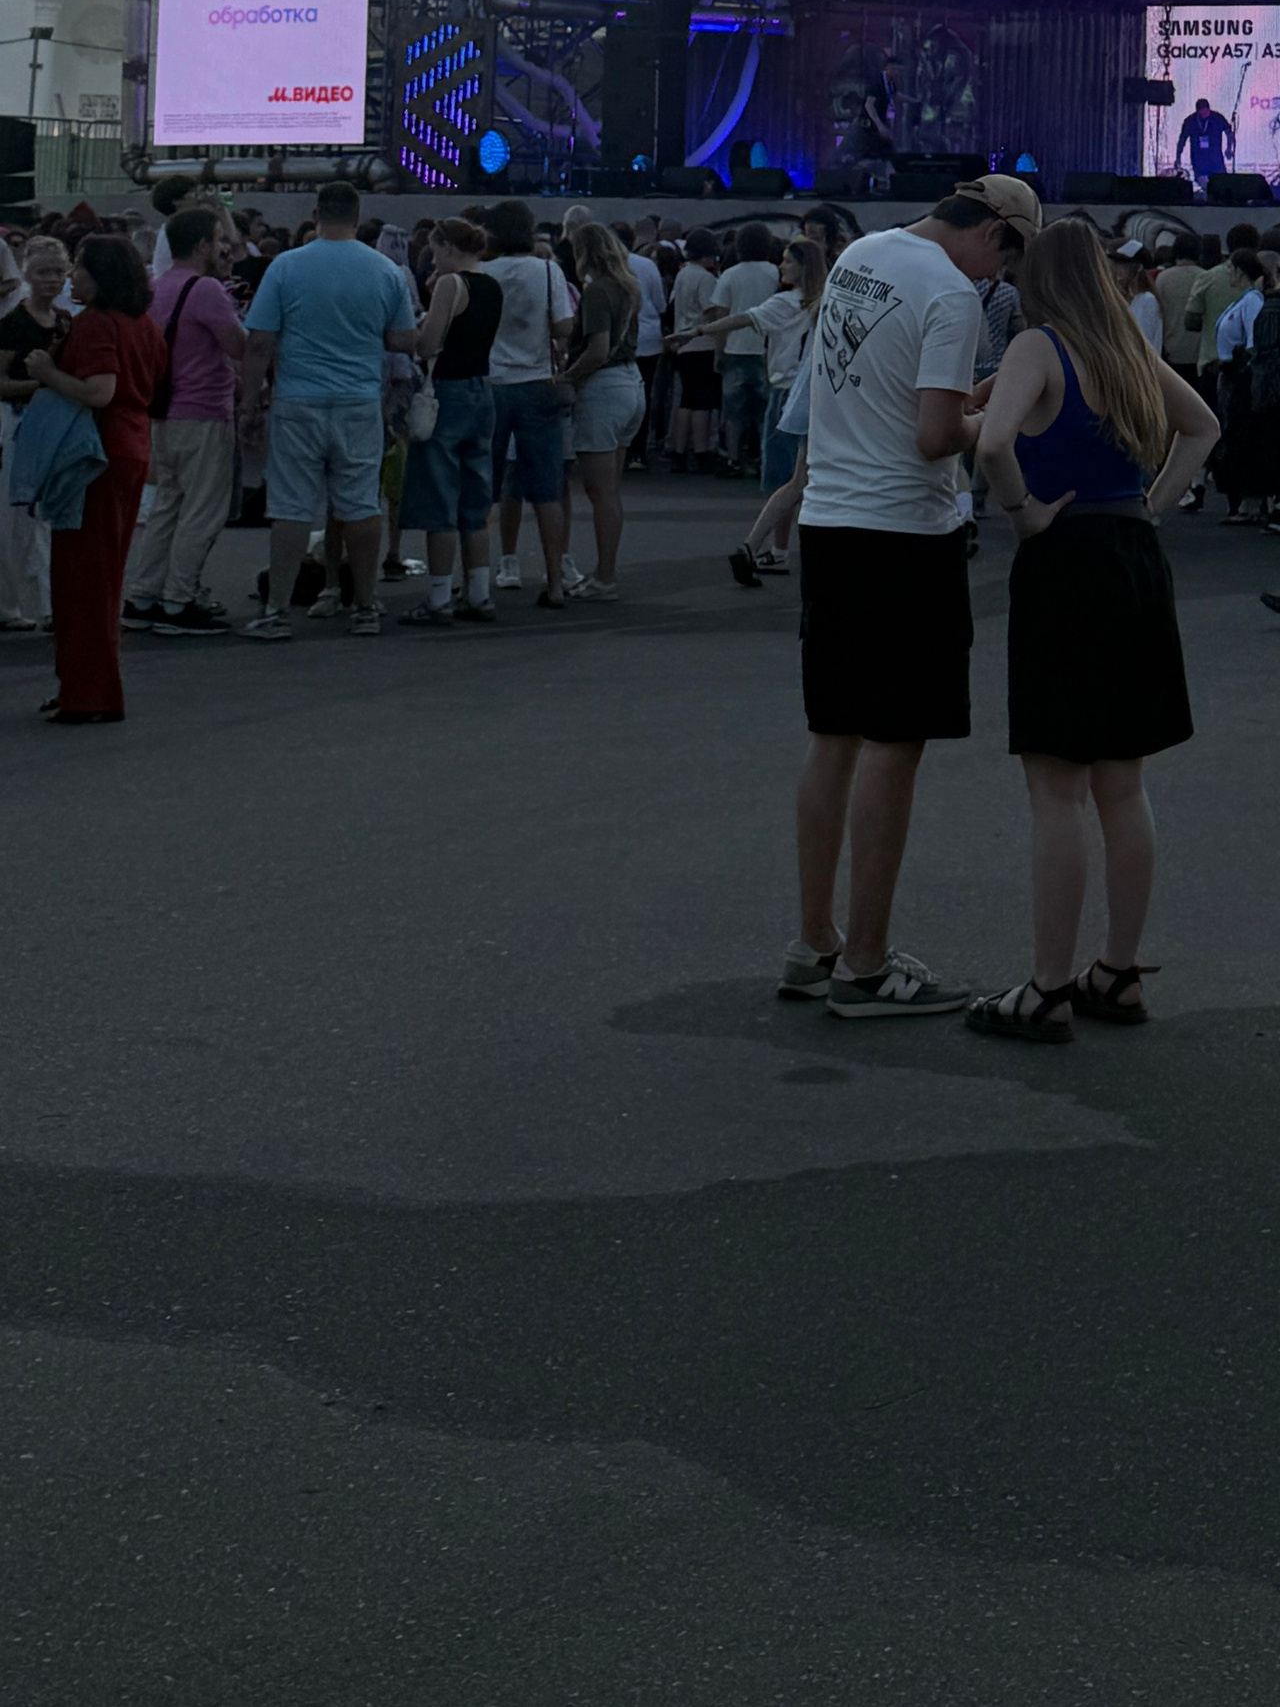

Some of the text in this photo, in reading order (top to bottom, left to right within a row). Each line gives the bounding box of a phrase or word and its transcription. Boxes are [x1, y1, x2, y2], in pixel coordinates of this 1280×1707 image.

[208, 5, 318, 30] обработка
[1158, 19, 1254, 36] SAMSUNG
[1157, 43, 1220, 63] Galaxy
[1221, 42, 1253, 59] A57
